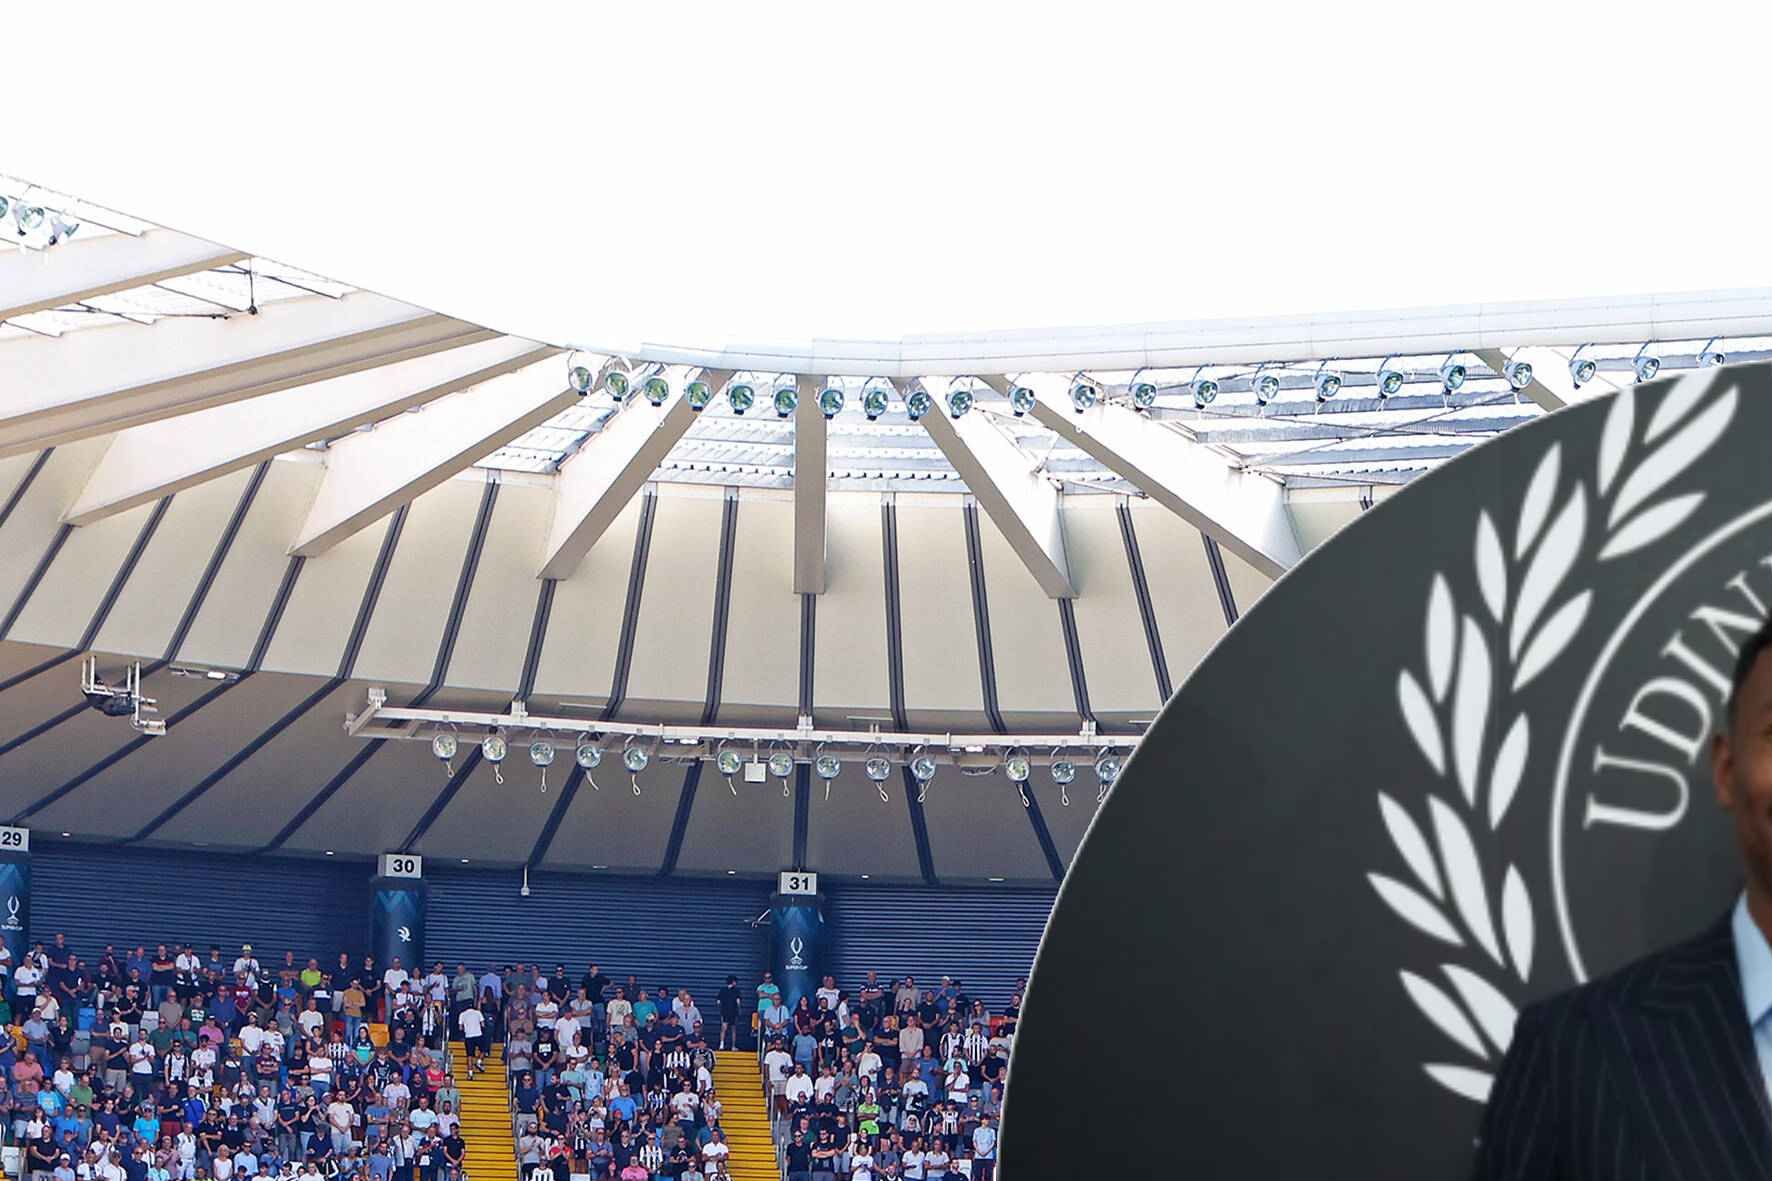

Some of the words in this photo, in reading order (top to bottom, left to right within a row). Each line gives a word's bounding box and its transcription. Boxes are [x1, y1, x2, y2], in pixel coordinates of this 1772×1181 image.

[1, 831, 22, 847] 29
[392, 859, 415, 873] 30
[789, 877, 809, 891] 31
